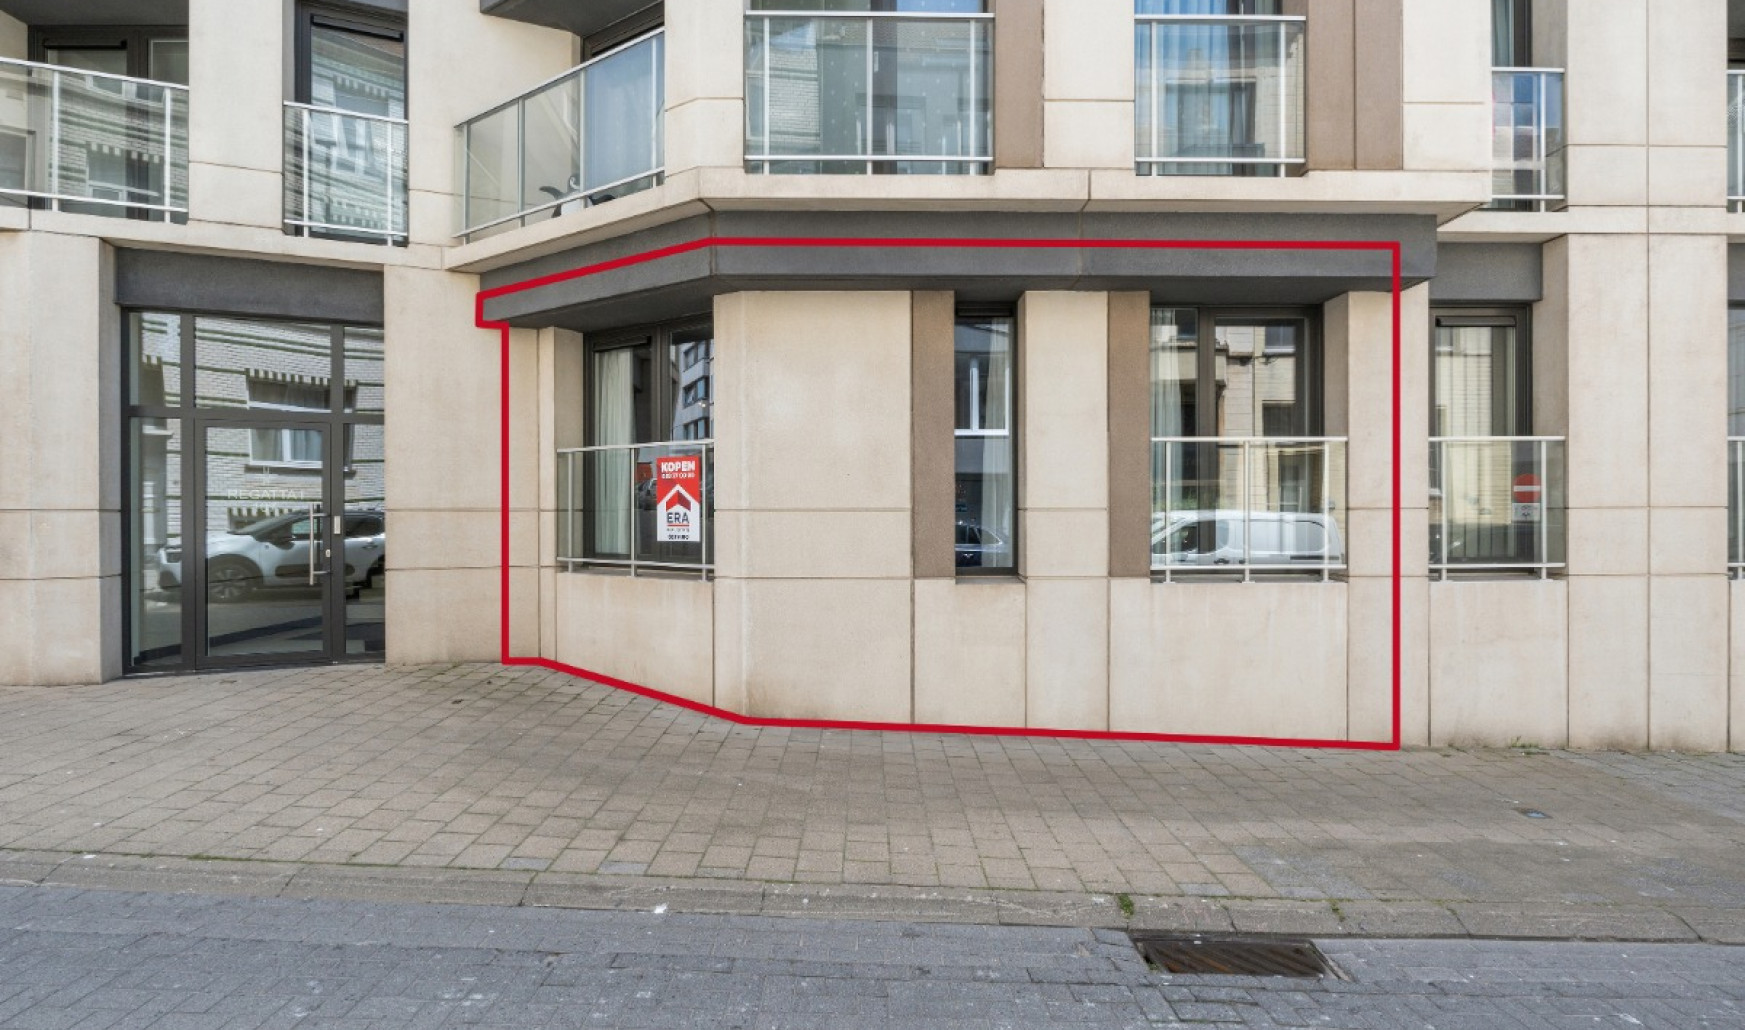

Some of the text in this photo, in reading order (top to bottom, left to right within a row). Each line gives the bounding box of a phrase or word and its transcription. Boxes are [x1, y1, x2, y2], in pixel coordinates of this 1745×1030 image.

[661, 460, 696, 473] KOPEN
[227, 489, 297, 499] REGATTA
[667, 512, 690, 523] ERA
